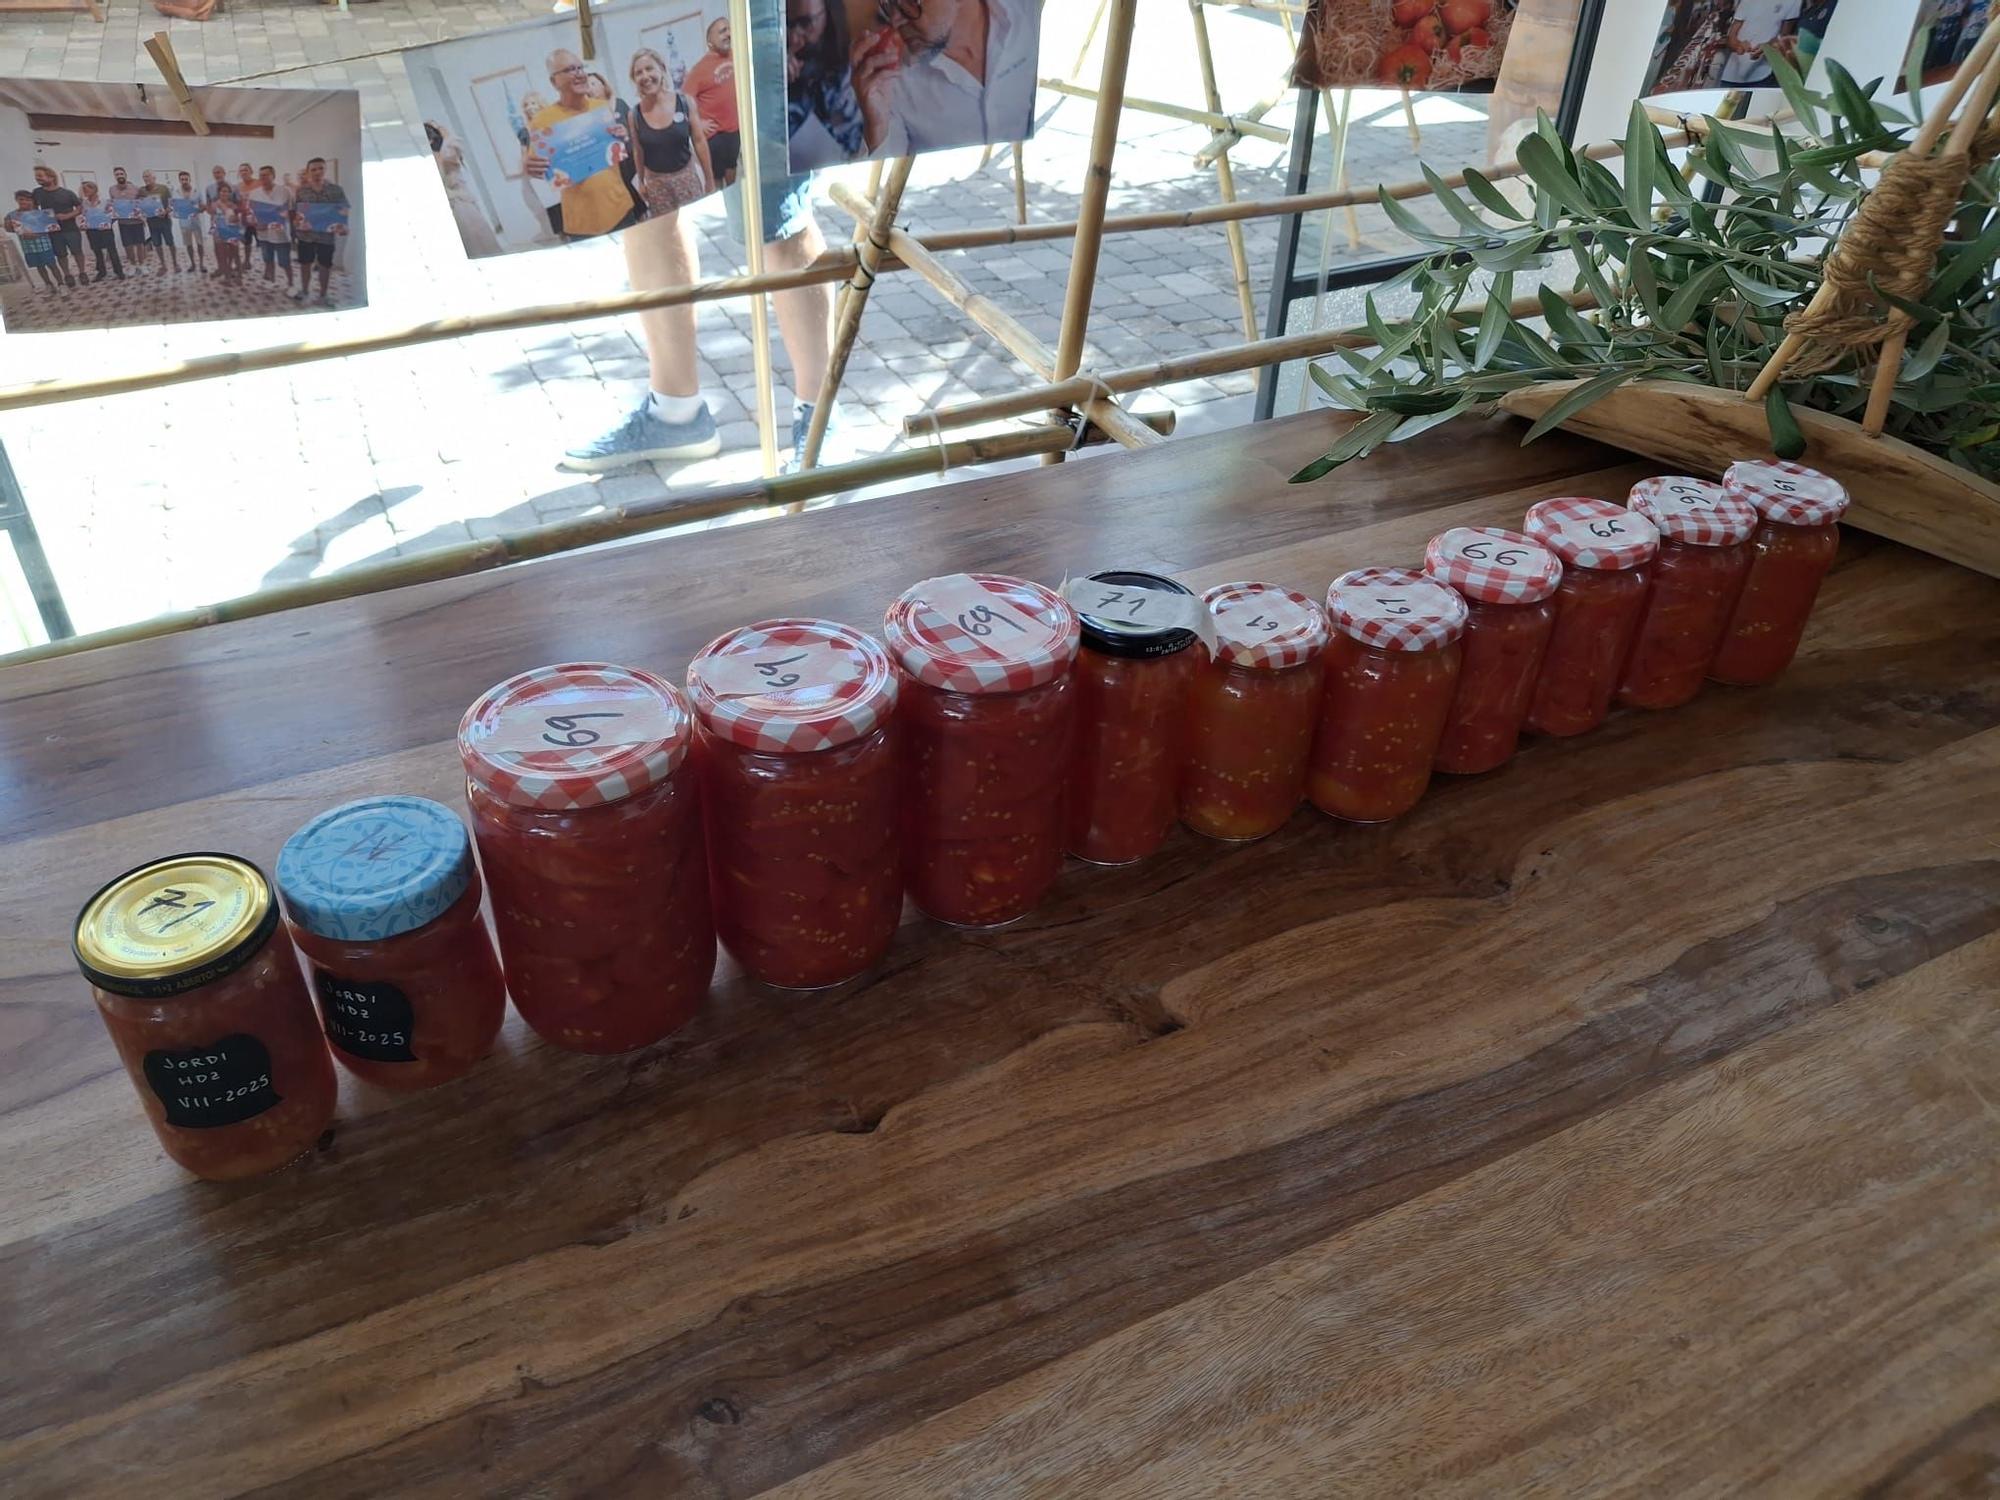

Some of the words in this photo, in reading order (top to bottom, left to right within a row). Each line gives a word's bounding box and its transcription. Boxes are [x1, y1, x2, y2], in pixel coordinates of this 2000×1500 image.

[1461, 542, 1529, 566] 66
[1096, 591, 1147, 616] 71
[957, 605, 1029, 637] 69
[542, 712, 625, 747] 69
[137, 888, 217, 935] 71
[326, 981, 376, 1004] JORDI
[163, 1052, 228, 1070] JORDI
[178, 1071, 221, 1087] HD2
[178, 1074, 270, 1109] VII-2025
